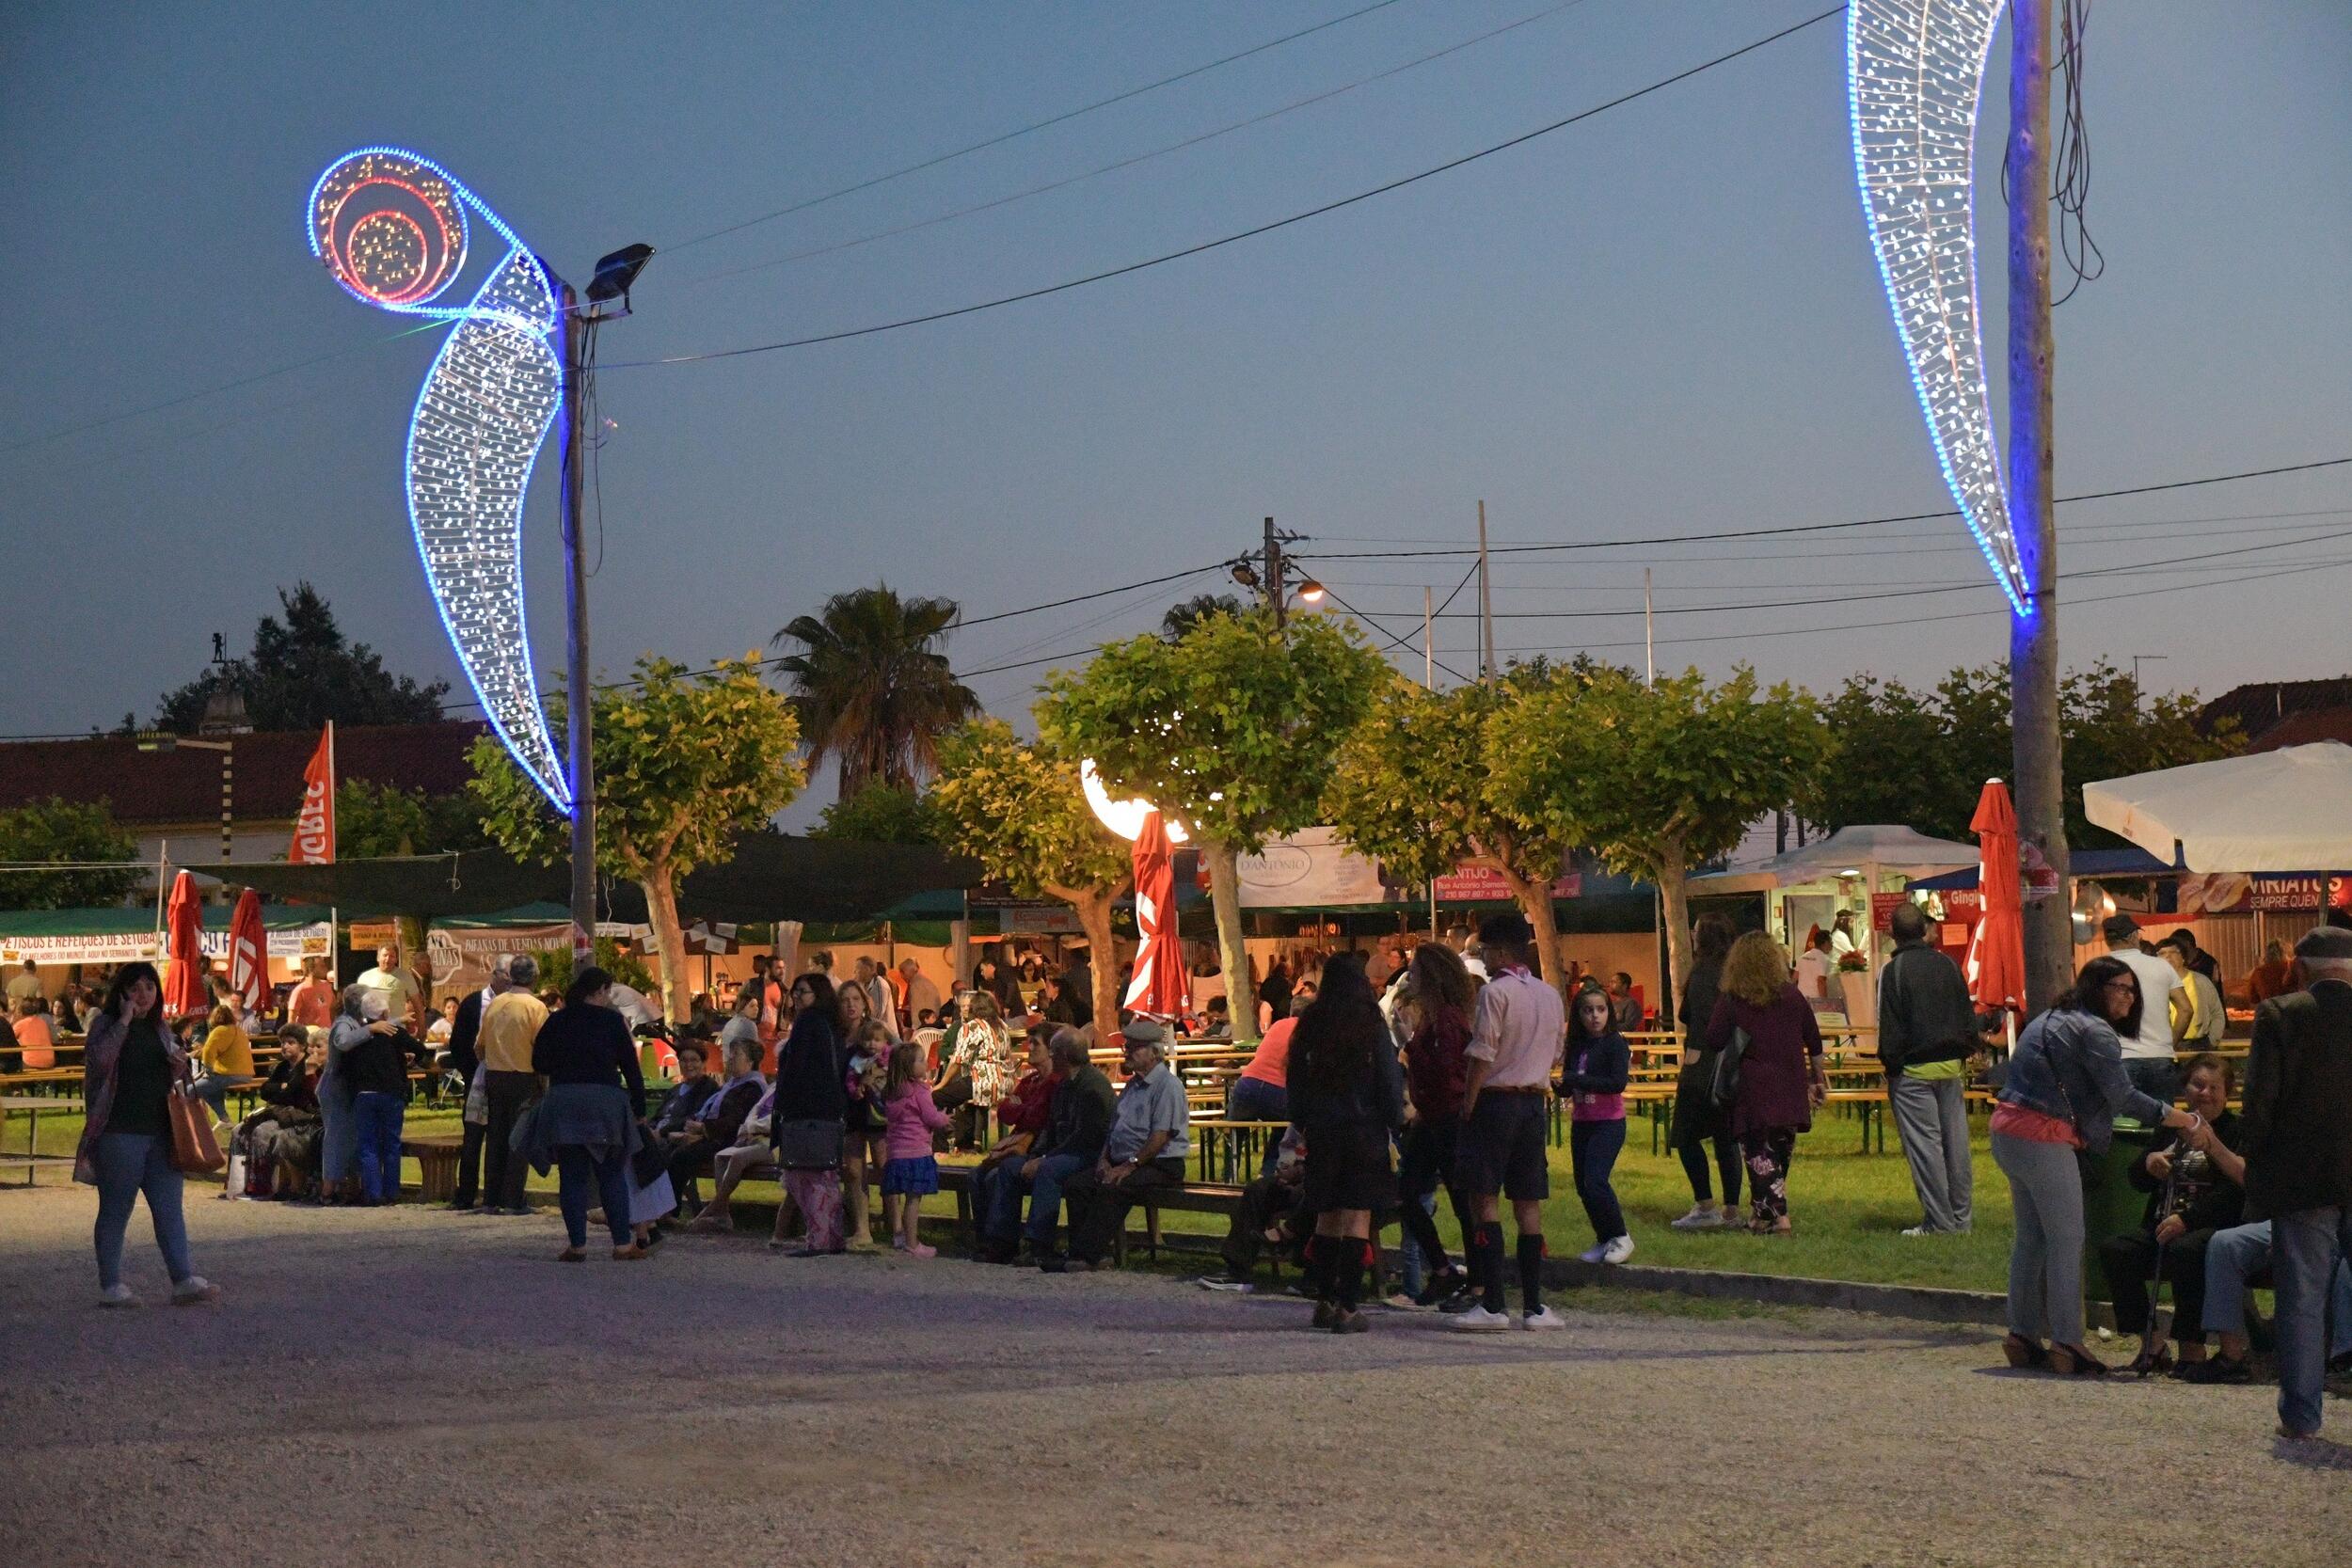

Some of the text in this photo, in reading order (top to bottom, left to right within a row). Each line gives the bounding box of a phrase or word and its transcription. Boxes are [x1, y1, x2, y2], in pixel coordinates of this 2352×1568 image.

[2249, 894, 2341, 909] SEMPRE QUENES.
[106, 933, 119, 946] DE
